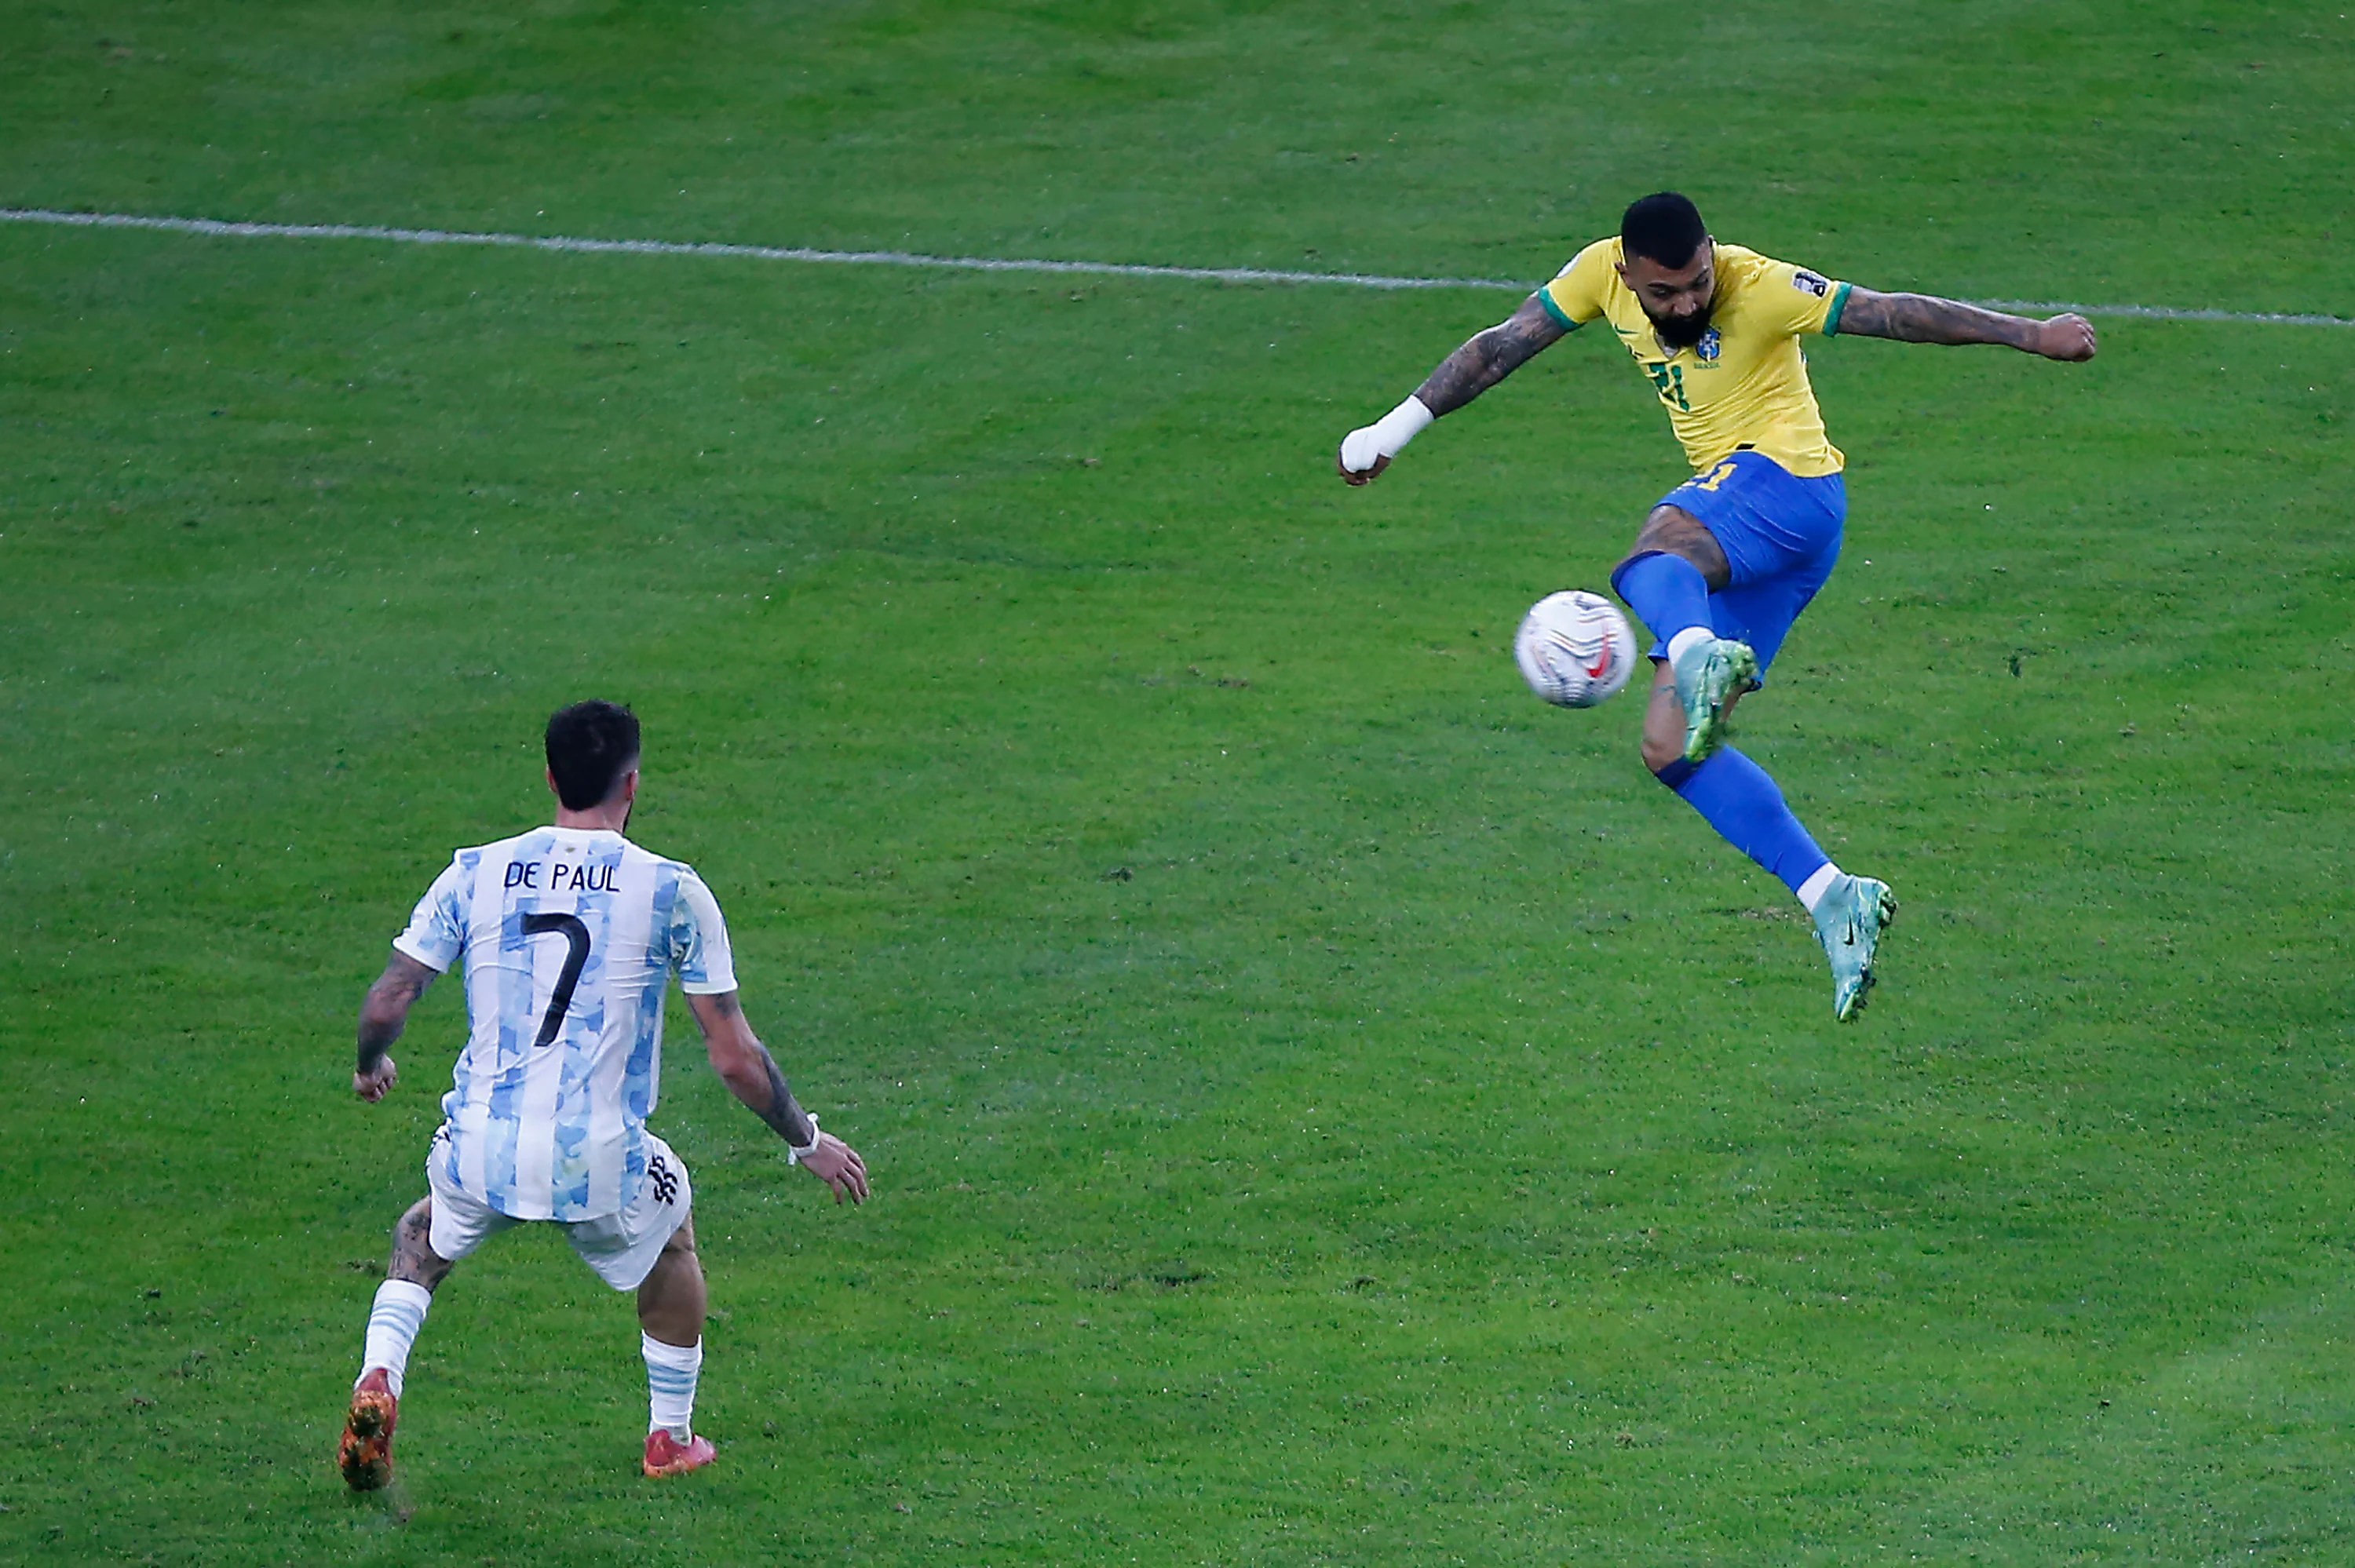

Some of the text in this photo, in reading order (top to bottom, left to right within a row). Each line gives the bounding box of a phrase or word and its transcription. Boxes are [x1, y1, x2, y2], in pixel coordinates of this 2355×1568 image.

[504, 862, 620, 892] DE PAUL
[520, 912, 591, 1047] 7
